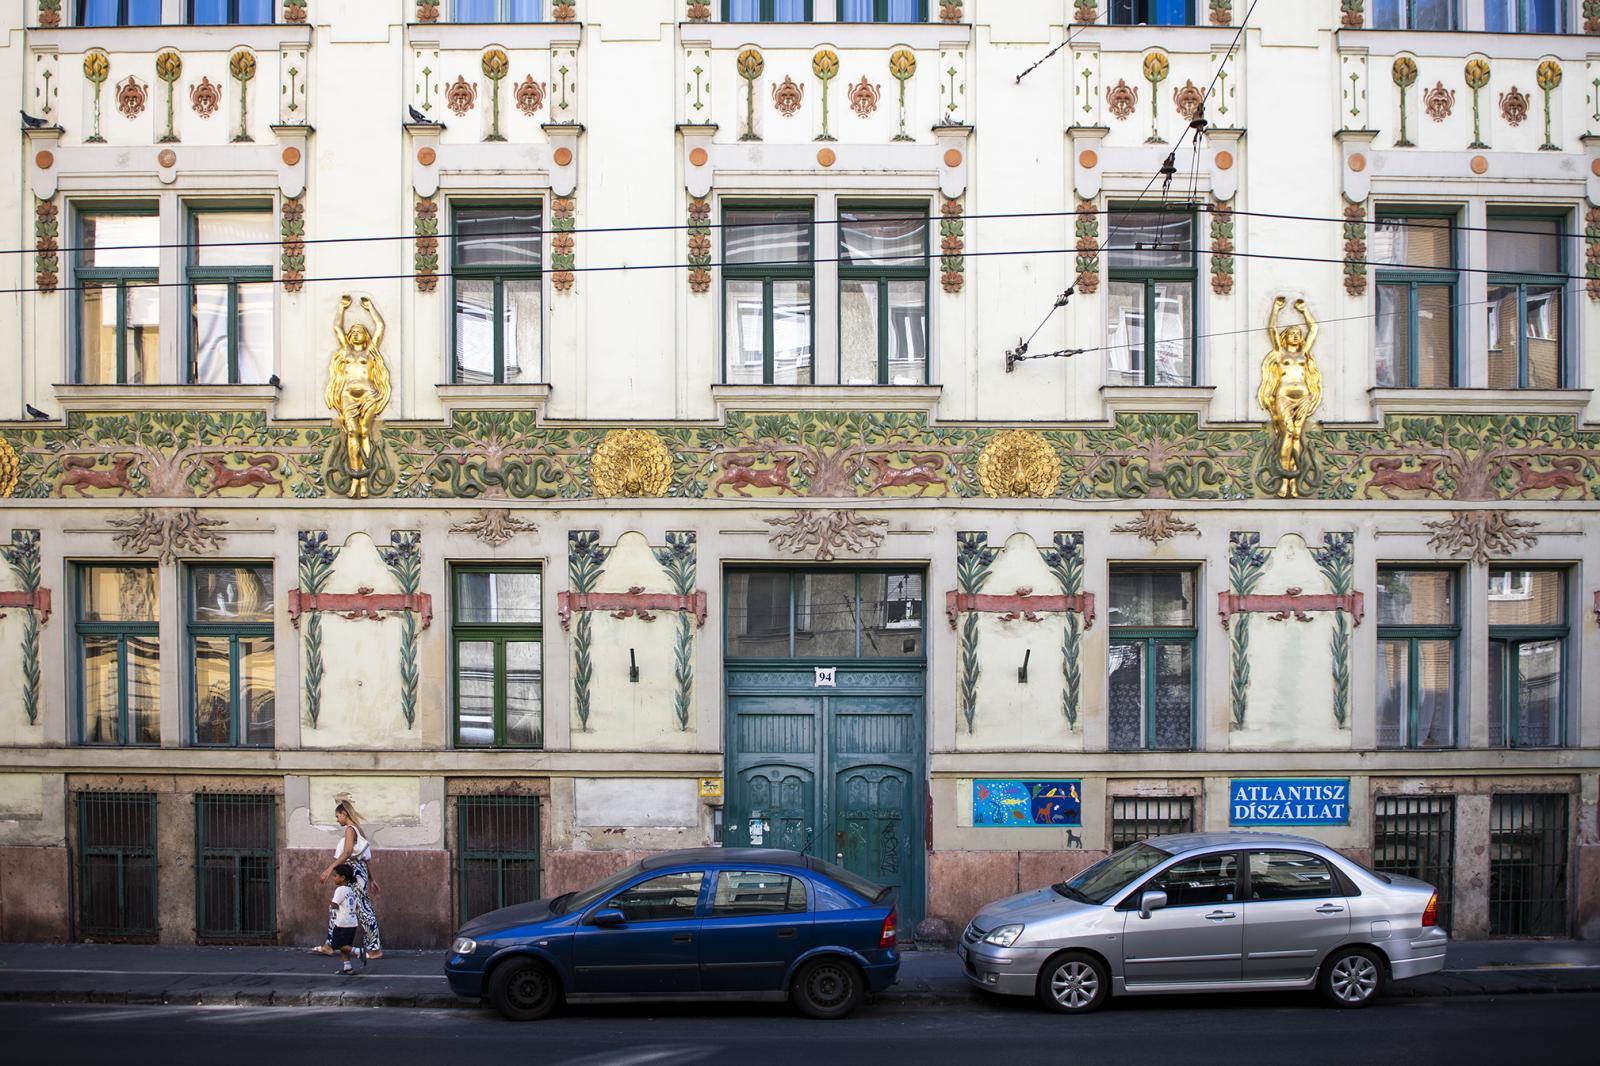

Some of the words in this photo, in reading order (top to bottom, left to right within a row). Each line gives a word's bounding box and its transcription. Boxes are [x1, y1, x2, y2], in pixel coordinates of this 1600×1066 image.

[819, 672, 832, 682] 94
[1234, 785, 1345, 801] ATLANTISZ
[1234, 802, 1345, 819] DÍSZÁLLAT
